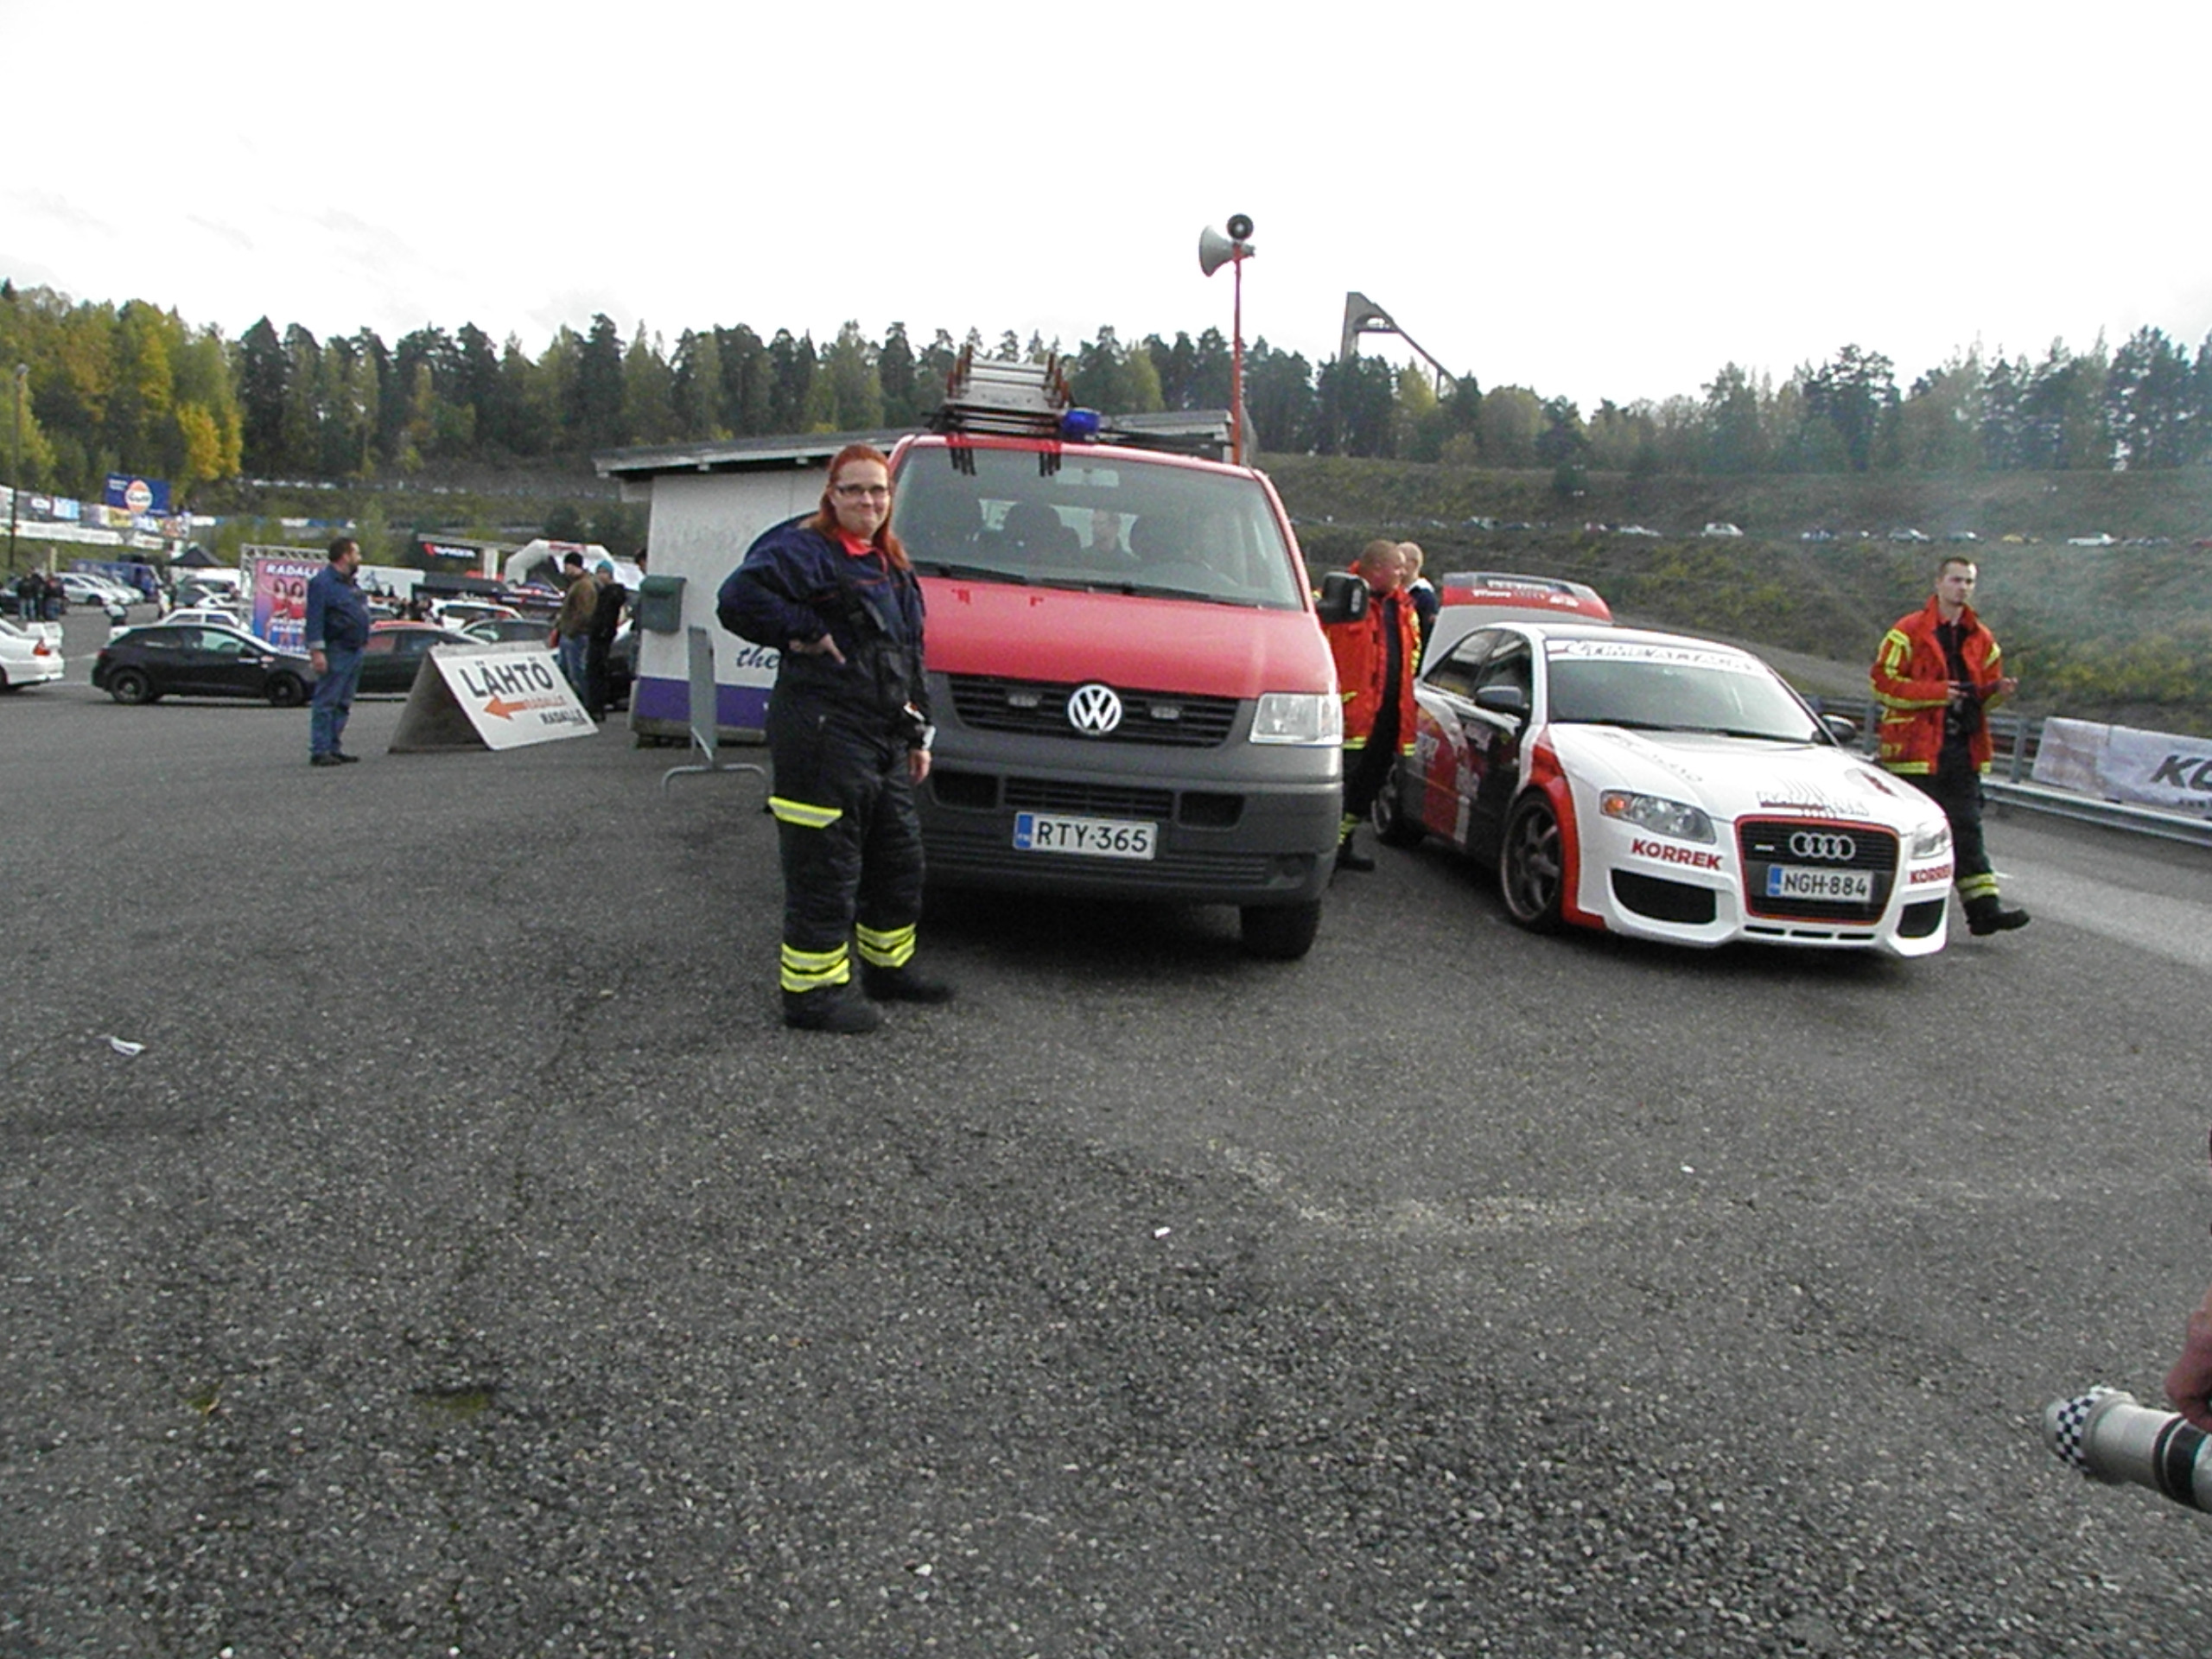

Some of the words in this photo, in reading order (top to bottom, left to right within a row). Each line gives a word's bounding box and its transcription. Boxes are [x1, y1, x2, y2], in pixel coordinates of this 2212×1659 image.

[737, 647, 779, 670] the
[459, 657, 554, 697] LÄHTÖ
[539, 709, 588, 726] RADALLE
[1037, 821, 1147, 853] RTY-365
[1631, 838, 1723, 870] KORREK
[1783, 874, 1867, 896] NGH-884
